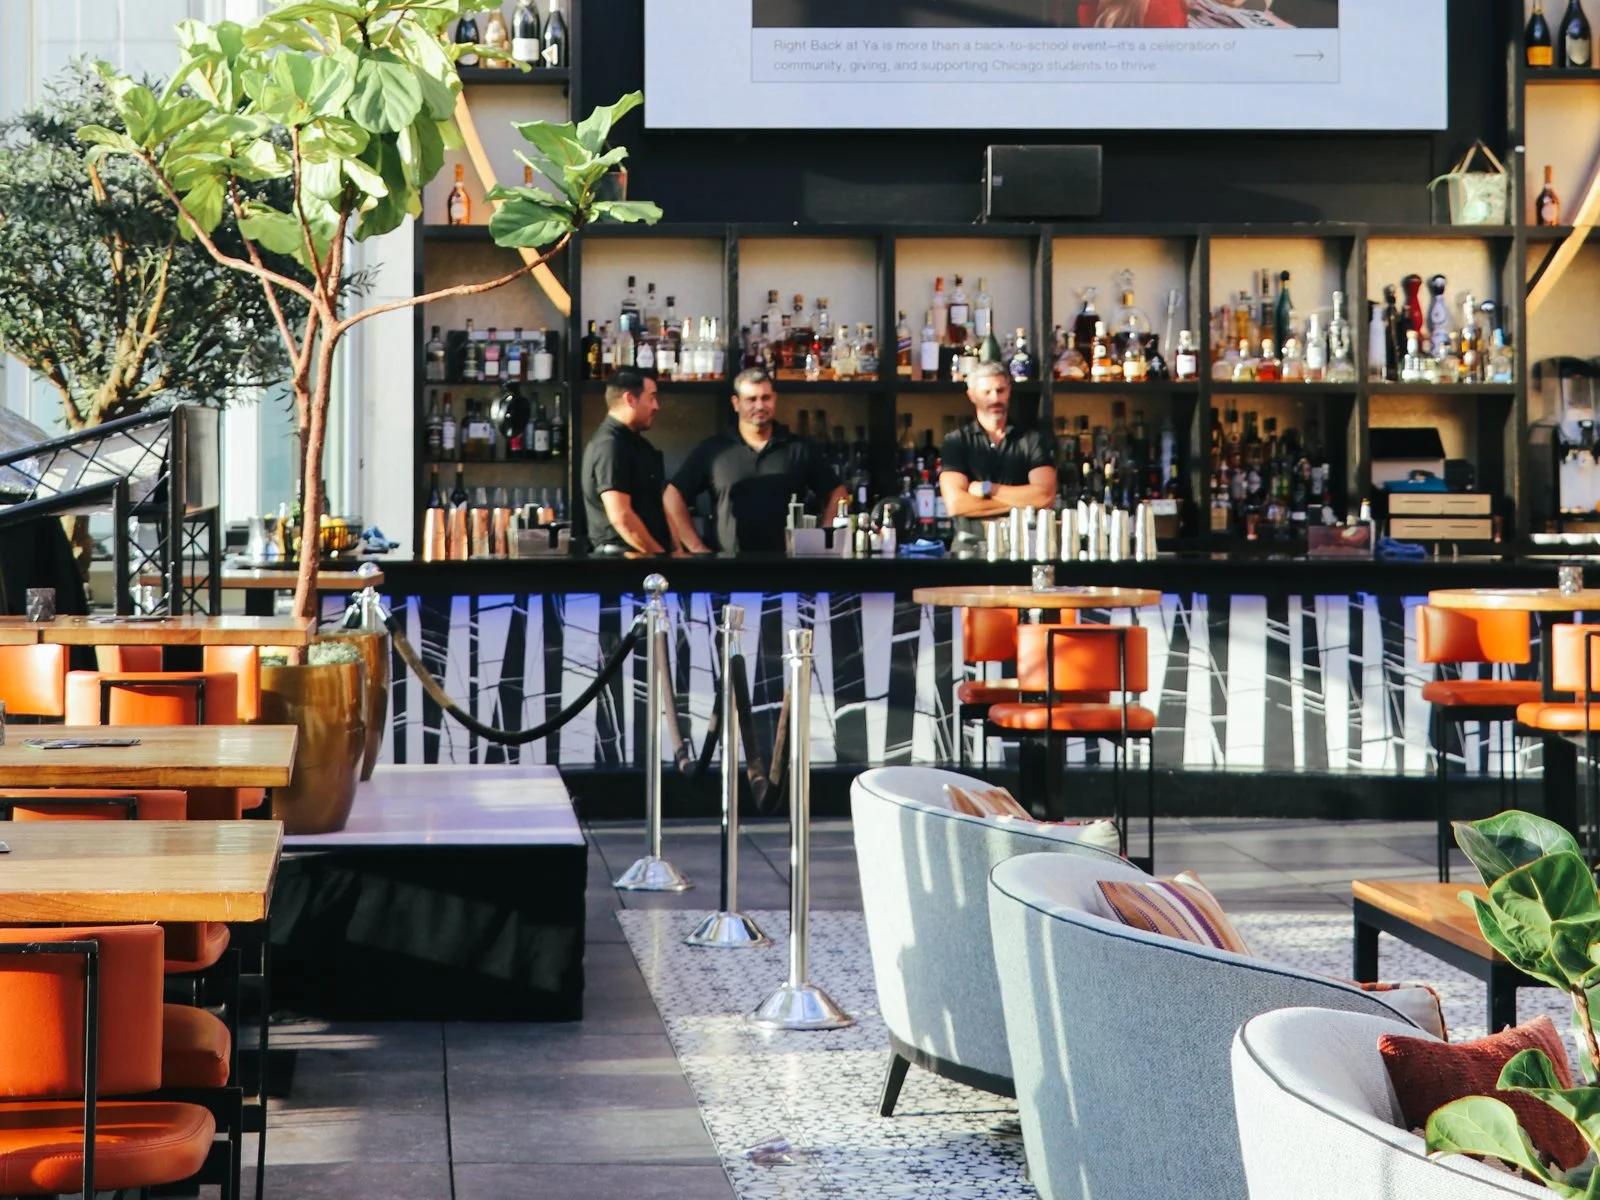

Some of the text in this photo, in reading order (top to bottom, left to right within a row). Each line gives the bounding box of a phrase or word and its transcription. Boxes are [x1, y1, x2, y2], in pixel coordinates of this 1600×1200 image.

[774, 39, 806, 54] Right
[811, 39, 842, 51] Back
[846, 41, 858, 51] at
[862, 39, 879, 51] Ya
[882, 40, 893, 51] is
[896, 42, 928, 51] more
[932, 40, 960, 51] than
[963, 42, 971, 51] a
[975, 40, 1068, 51] back-to-school
[1139, 42, 1146, 51] a
[1150, 40, 1220, 51] celebration
[1223, 40, 1237, 51] of
[774, 59, 846, 73] community,
[849, 60, 891, 74] giving,
[894, 60, 918, 71] and
[921, 60, 988, 74] supporting
[992, 59, 1043, 74] Chicago
[1047, 60, 1101, 71] students
[1105, 60, 1118, 71] to
